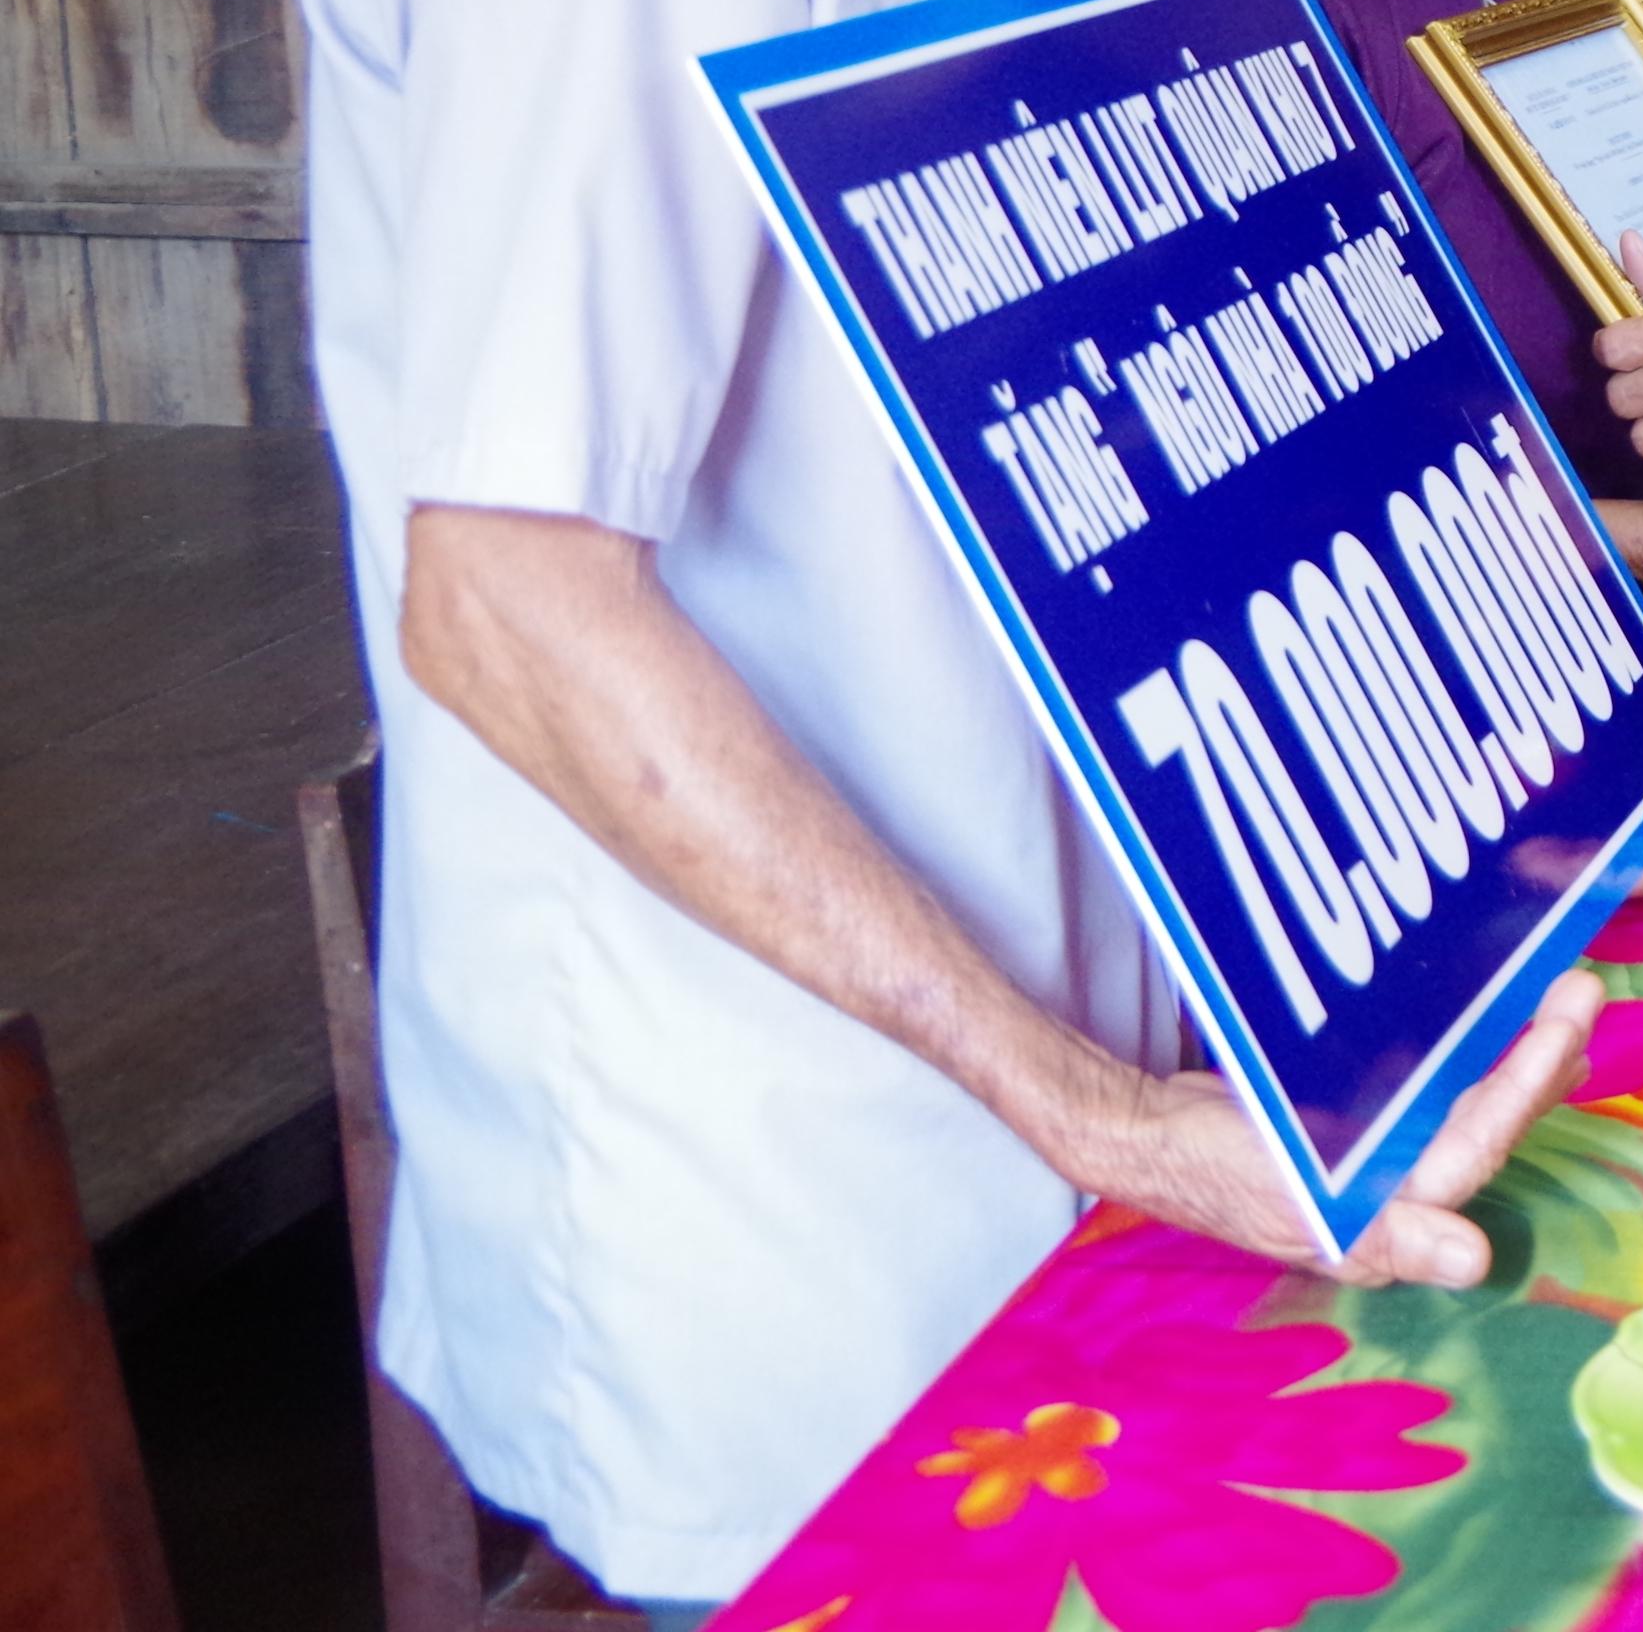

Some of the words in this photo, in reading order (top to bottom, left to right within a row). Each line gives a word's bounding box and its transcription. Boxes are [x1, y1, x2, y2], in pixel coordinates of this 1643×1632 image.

[841, 151, 1044, 340] THANH
[985, 99, 1135, 283] NIÊN
[1156, 46, 1287, 223] QUÂN
[1234, 45, 1337, 176] KHU
[1289, 40, 1357, 152] 7
[980, 378, 1151, 595] TẶNG
[1204, 266, 1327, 447] NHÀ
[1276, 264, 1375, 403] 100
